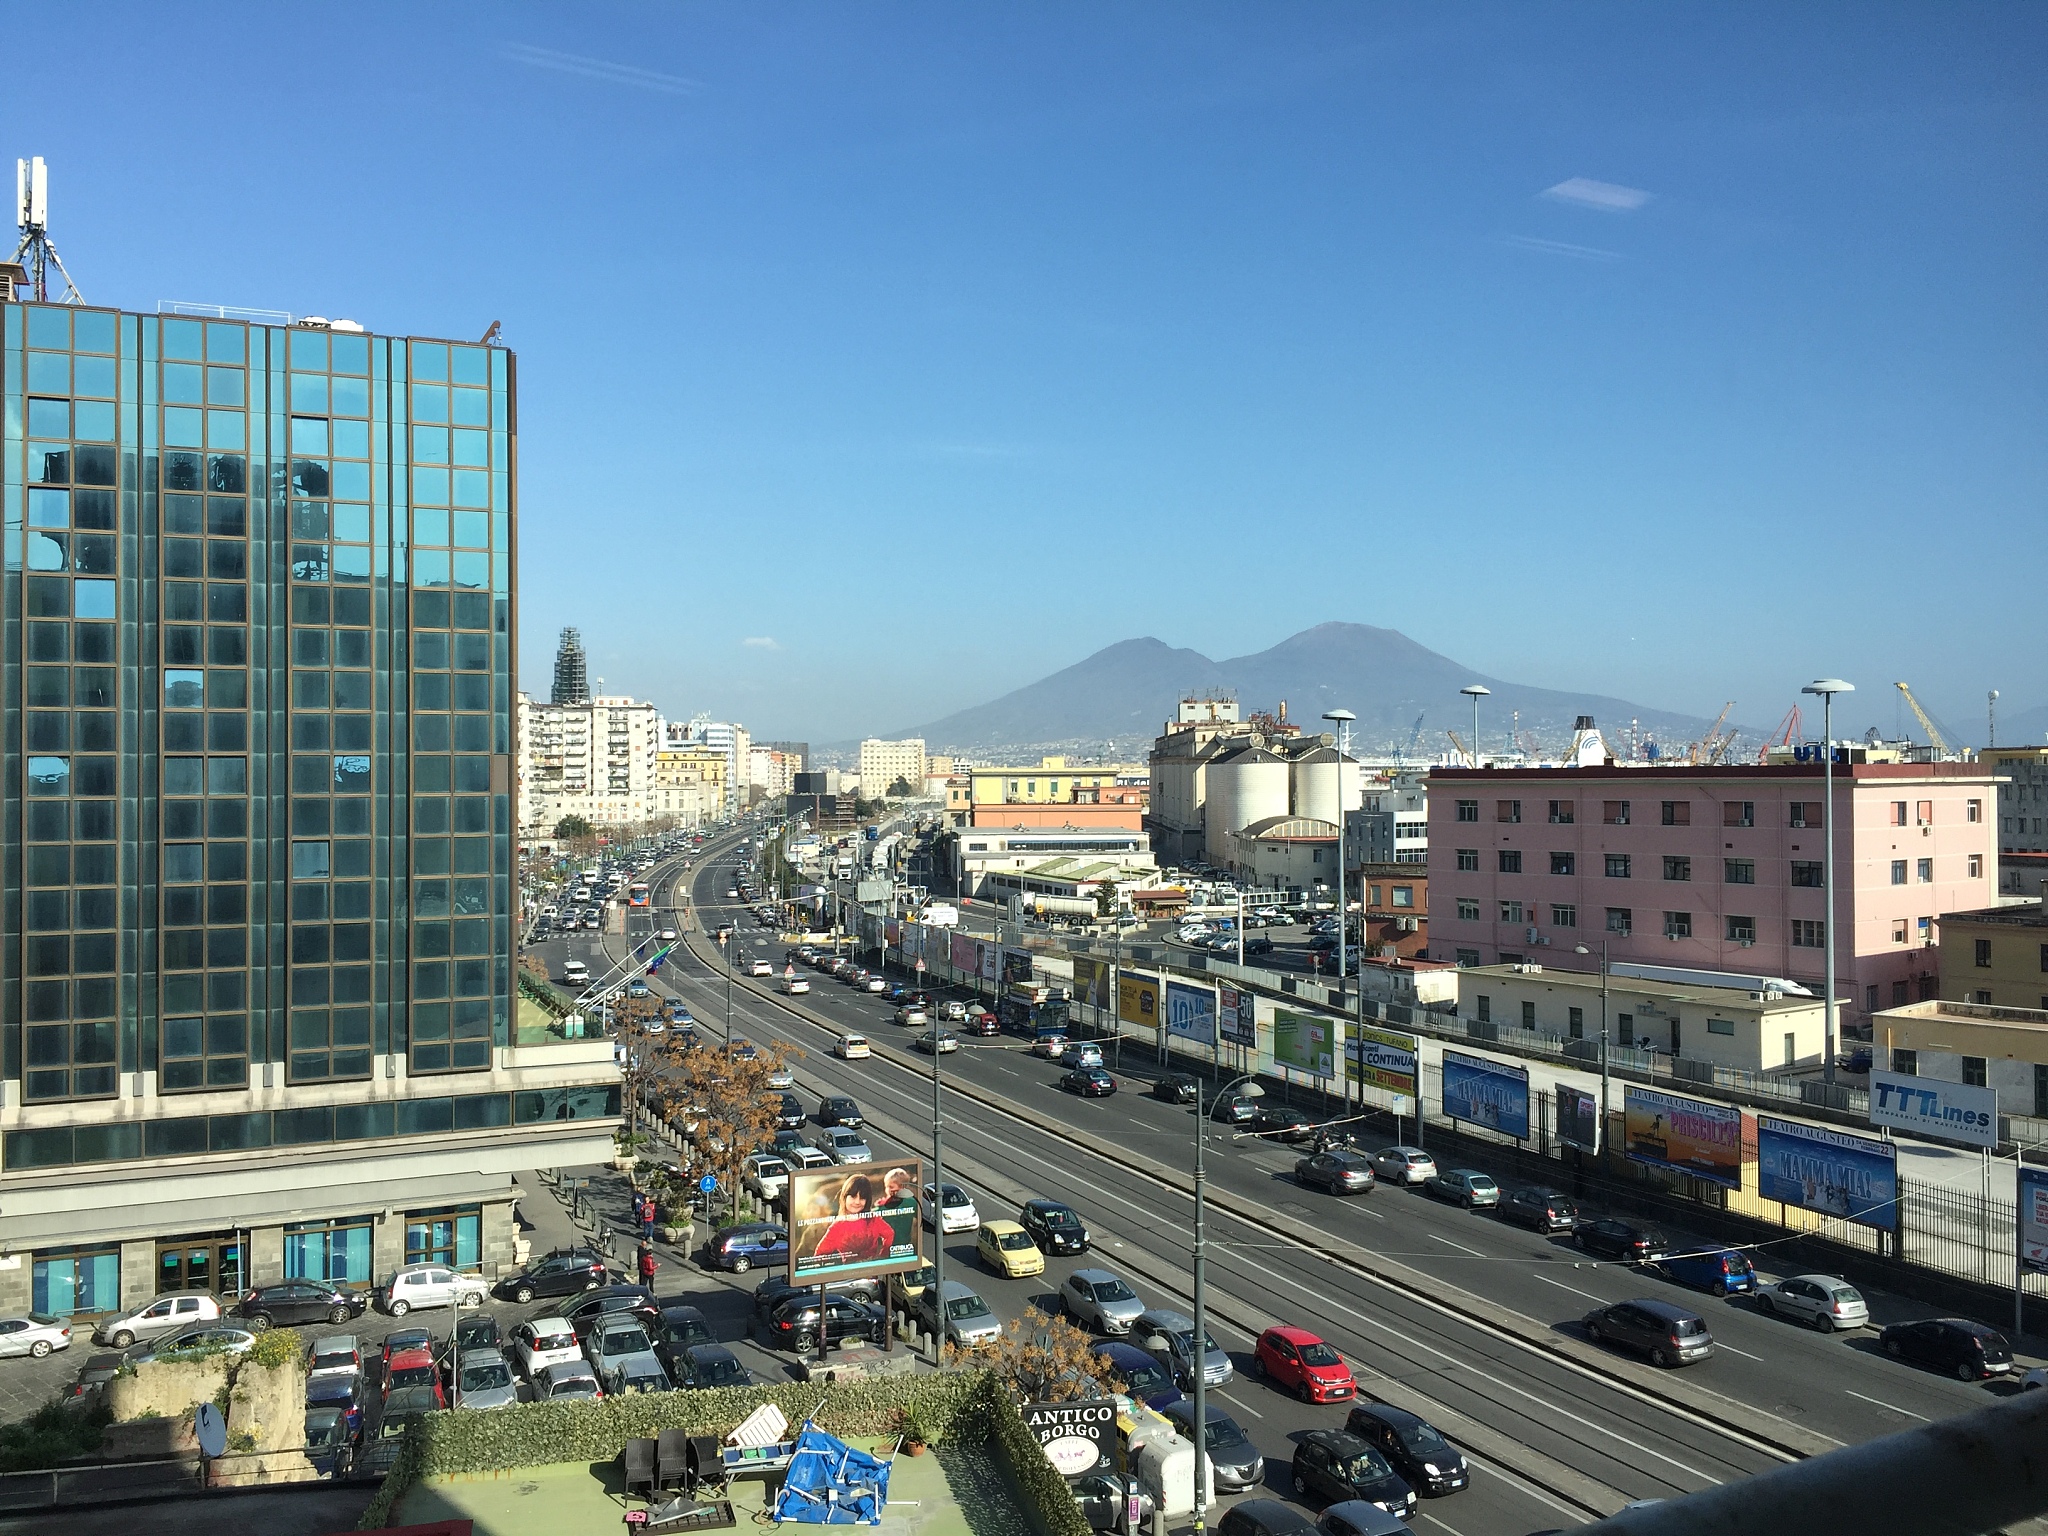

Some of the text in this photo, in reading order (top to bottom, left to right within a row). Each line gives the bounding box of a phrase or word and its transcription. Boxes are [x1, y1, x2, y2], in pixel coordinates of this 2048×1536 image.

[1367, 1053, 1414, 1068] CONTINUA
[1634, 1089, 1709, 1114] TEATRO AUGUSTEO
[1670, 1111, 1737, 1148] PRISCILLA
[1768, 1120, 1855, 1147] TEATRO AUGUSTEO
[1875, 1109, 1918, 1121] COMPAGNIA
[1935, 1121, 1989, 1135] NAVIGAZIONE
[1880, 1145, 1889, 1155] 22
[1780, 1151, 1872, 1199] MAMMA MIA!
[1028, 1407, 1112, 1426] ANTICO
[1041, 1423, 1100, 1443] BORGO
